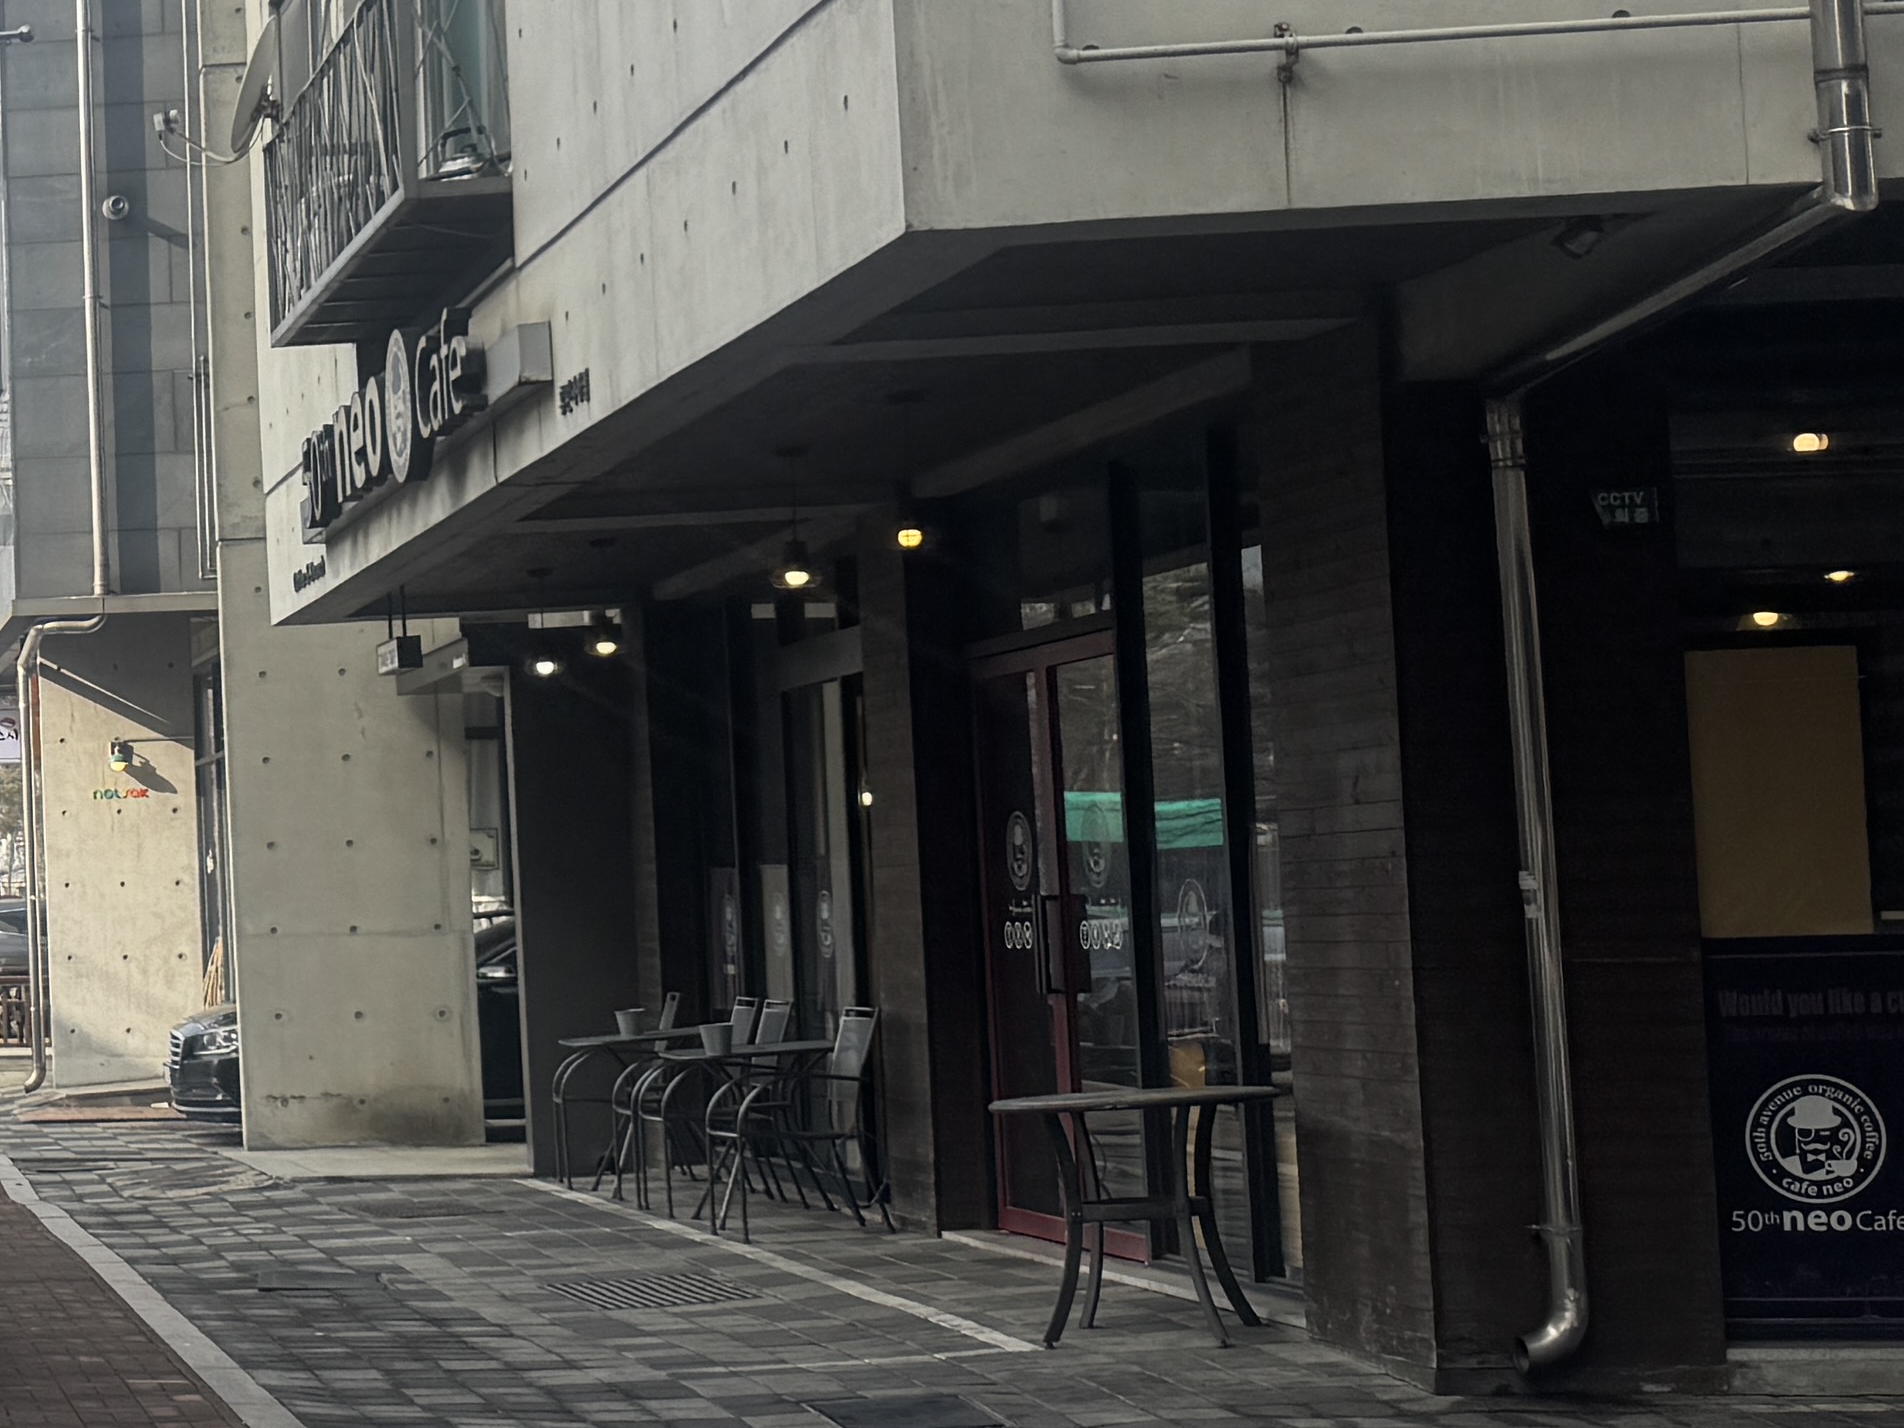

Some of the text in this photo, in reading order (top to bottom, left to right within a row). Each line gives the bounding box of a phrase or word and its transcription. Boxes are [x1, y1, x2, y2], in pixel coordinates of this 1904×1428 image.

[334, 376, 381, 503] neo
[415, 308, 466, 438] Cafe
[1597, 491, 1644, 506] CCTV
[1786, 992, 1824, 1018] you
[1760, 1085, 1803, 1125] avenue
[1808, 1083, 1864, 1114] organic
[1860, 1114, 1879, 1160] coffee
[1782, 1177, 1854, 1196] cafe neo
[1731, 1209, 1904, 1232] 50th neo Cafe
